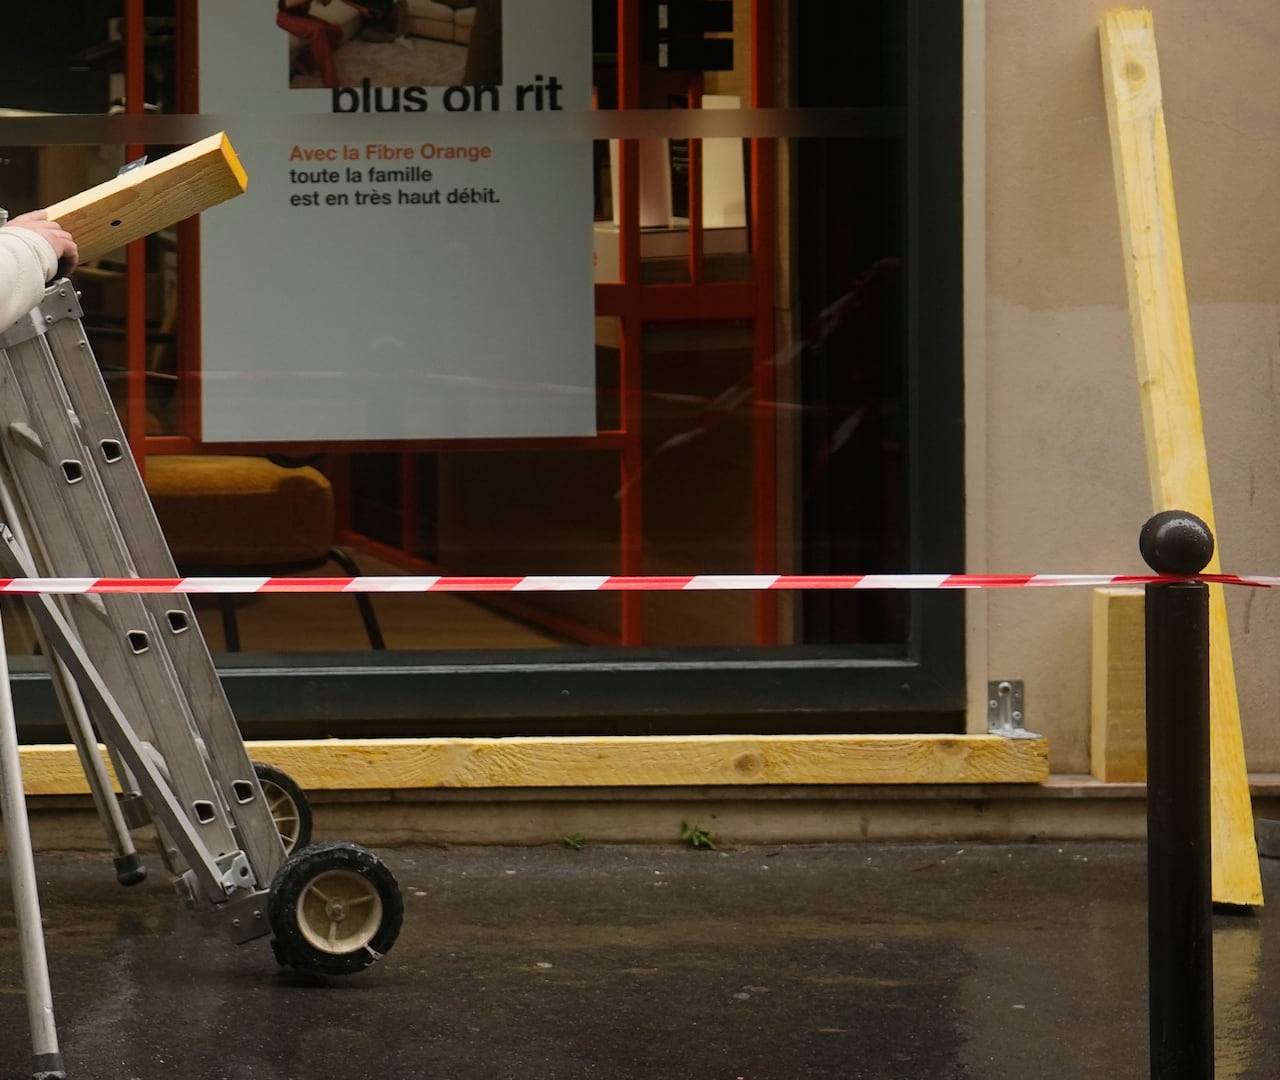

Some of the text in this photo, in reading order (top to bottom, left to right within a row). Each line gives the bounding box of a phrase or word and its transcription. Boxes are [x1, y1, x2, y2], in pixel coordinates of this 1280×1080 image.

[332, 74, 563, 113] plus on rit
[289, 143, 492, 162] Avec la Fibre Orange
[290, 166, 432, 184] toute la famille
[290, 187, 500, 207] est en très haut débit.
